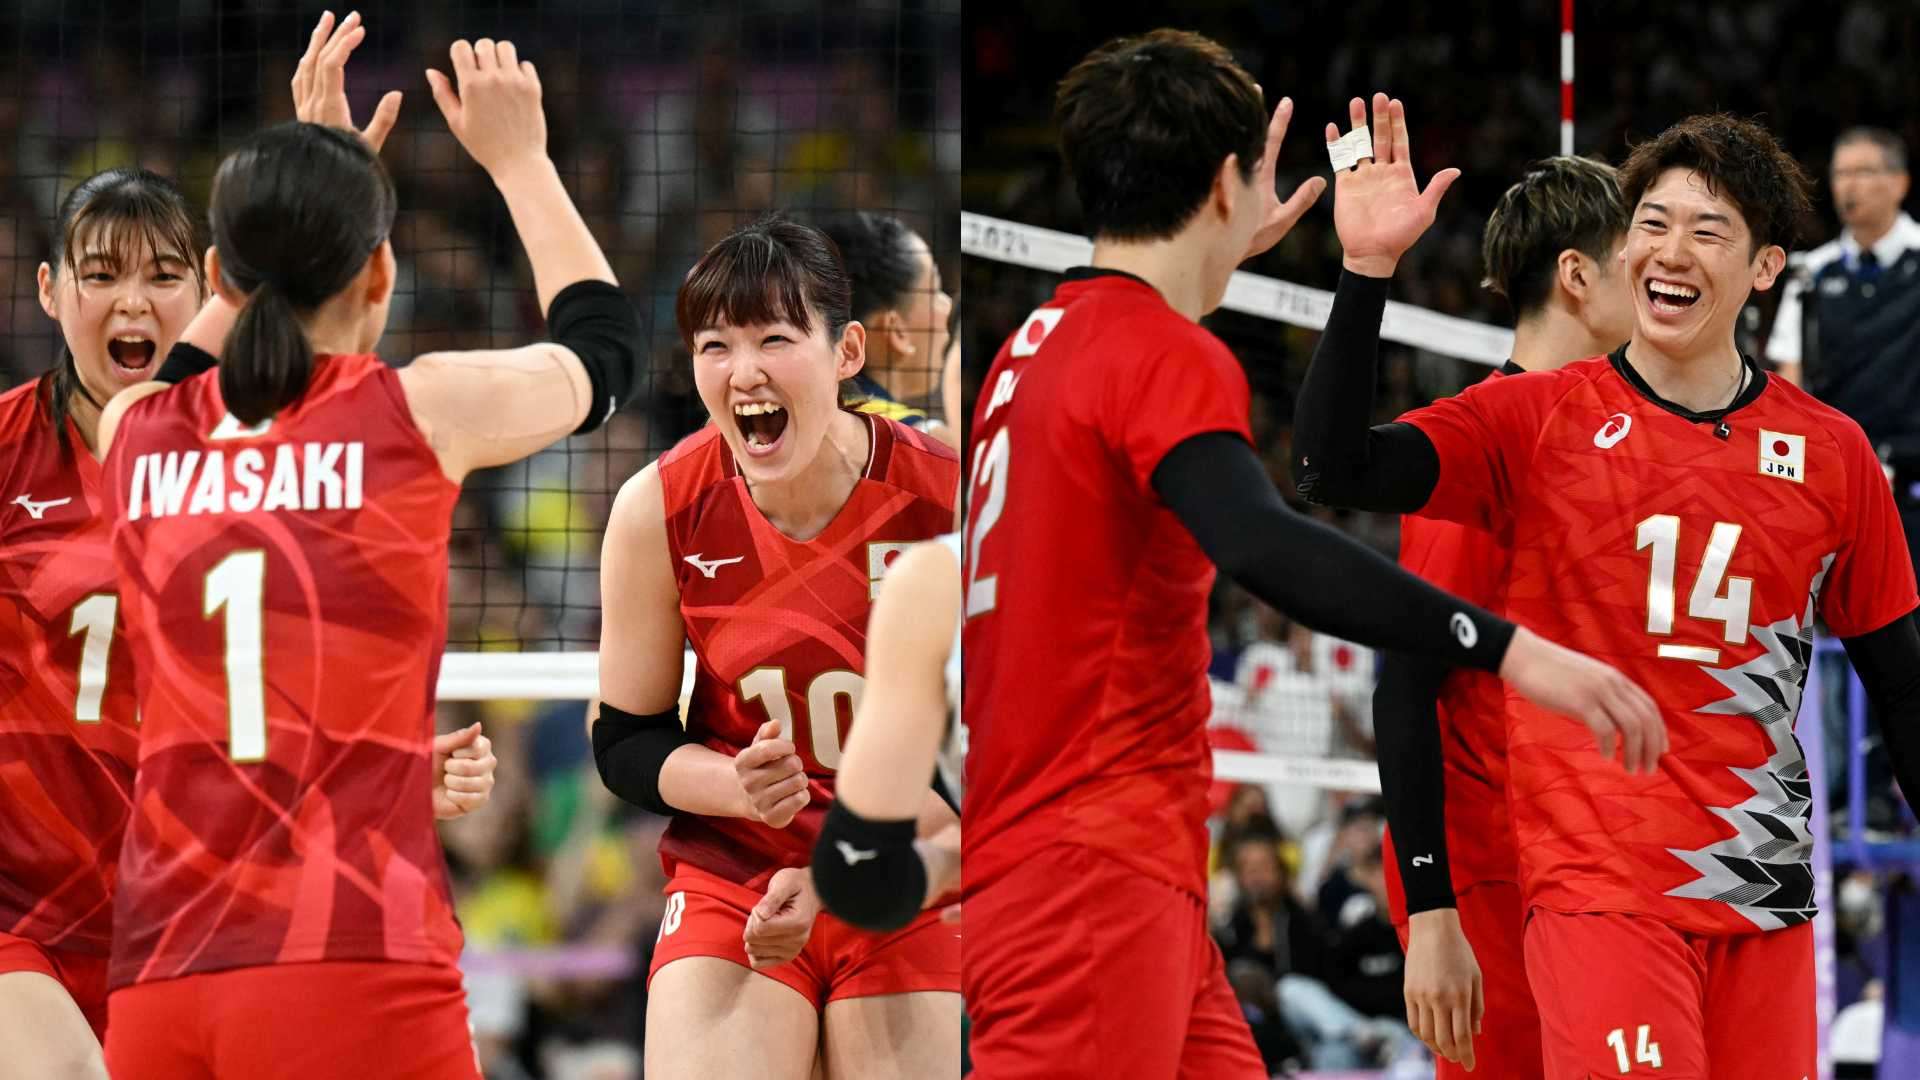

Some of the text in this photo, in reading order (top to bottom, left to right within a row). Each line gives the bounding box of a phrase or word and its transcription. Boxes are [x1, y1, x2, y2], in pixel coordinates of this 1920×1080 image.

[128, 441, 364, 521] IWASAKI
[1767, 462, 1795, 477] JPN
[1635, 513, 1753, 645] 14
[68, 591, 141, 724] 1
[204, 549, 267, 763] 1
[736, 666, 866, 771] 10
[1605, 1024, 1663, 1075] 14
